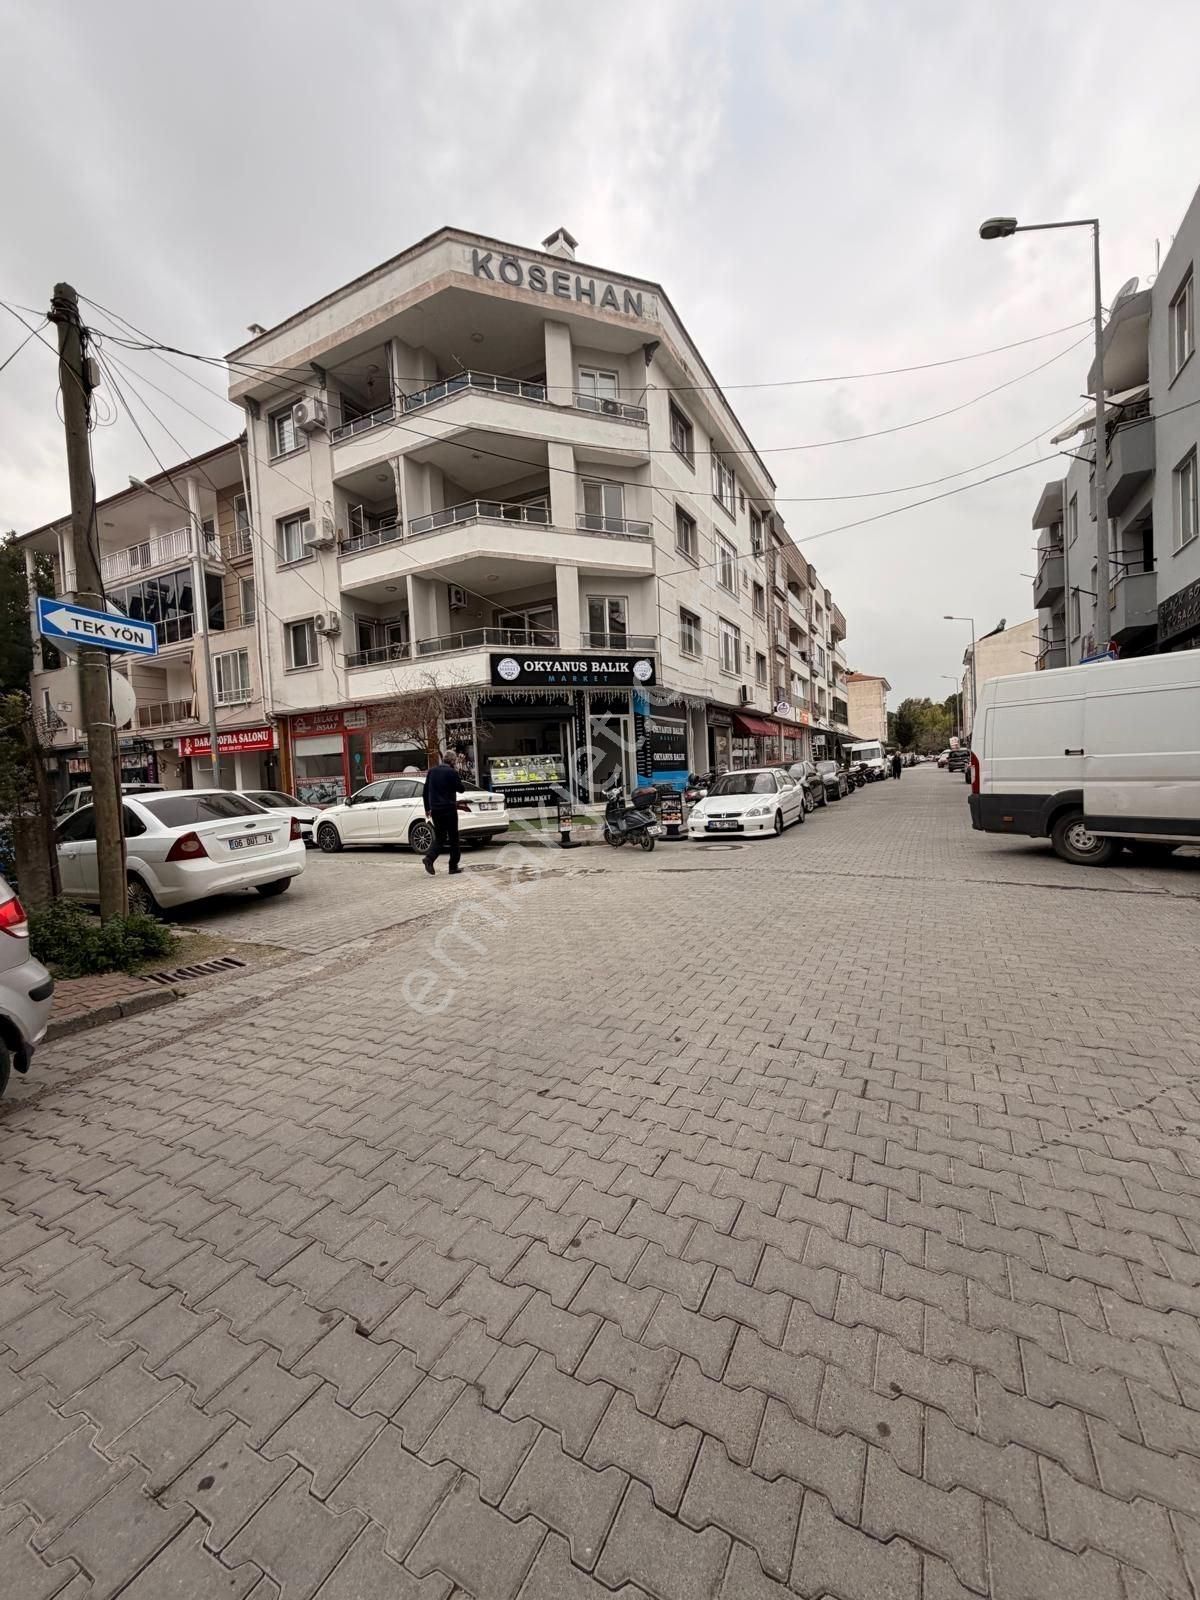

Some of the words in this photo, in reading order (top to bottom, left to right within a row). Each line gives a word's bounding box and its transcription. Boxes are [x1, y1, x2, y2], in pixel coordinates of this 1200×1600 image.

[472, 248, 643, 317] KÖSEHAN
[71, 617, 106, 636] TEK
[110, 626, 145, 644] YÖN
[523, 660, 588, 673] OKYANUS
[591, 661, 630, 673] BALIK
[239, 731, 269, 743] SALONU
[524, 794, 551, 803] MARKET
